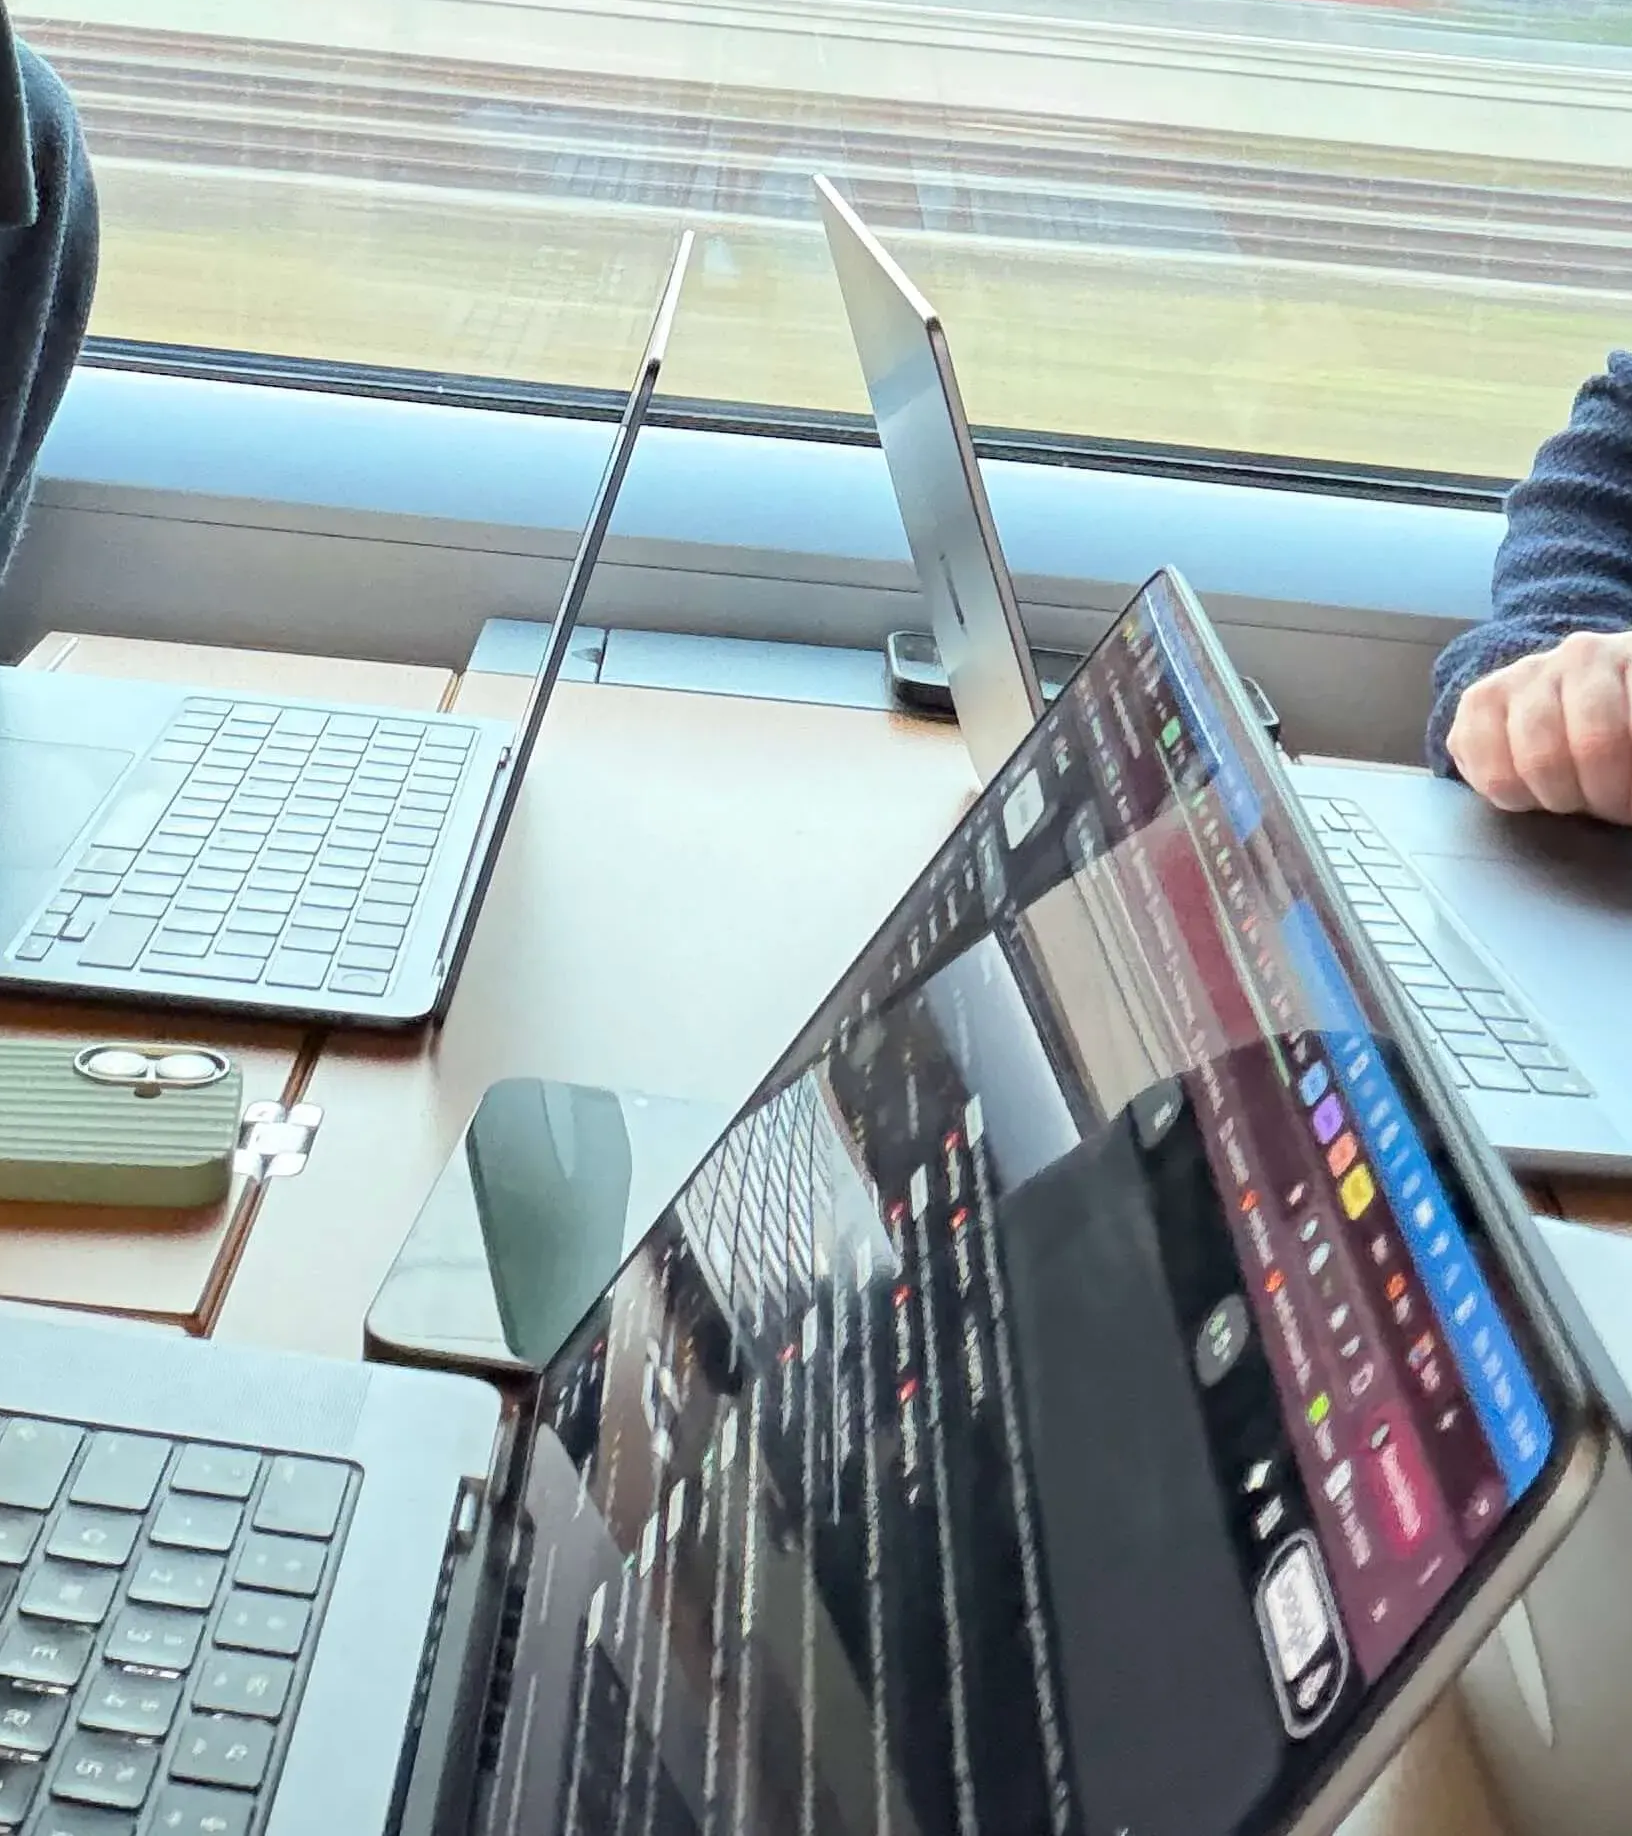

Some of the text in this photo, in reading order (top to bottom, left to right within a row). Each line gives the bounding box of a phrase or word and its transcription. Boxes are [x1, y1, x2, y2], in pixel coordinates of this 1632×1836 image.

[30, 1646, 59, 1660] E
[2, 1708, 32, 1727] R
[74, 1758, 104, 1779] 5
